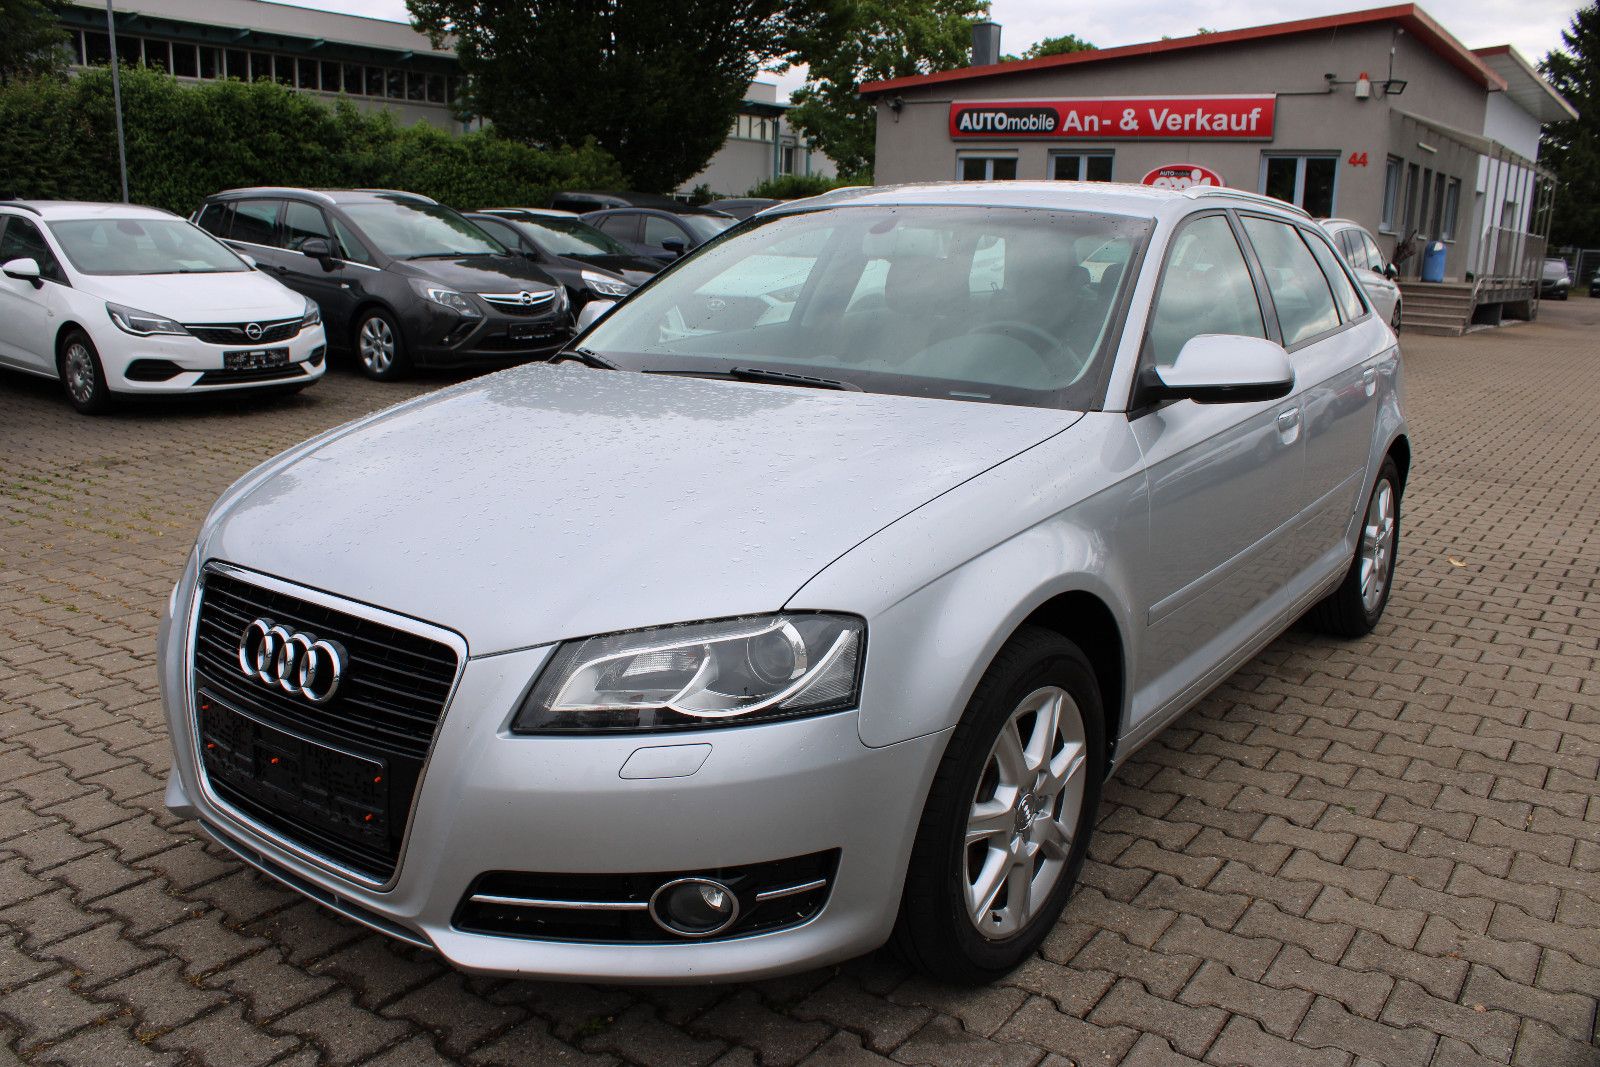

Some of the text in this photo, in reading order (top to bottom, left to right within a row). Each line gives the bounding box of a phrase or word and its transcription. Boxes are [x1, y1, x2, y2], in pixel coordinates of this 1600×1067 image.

[959, 107, 1262, 132] AUTOmobile An- & Verkauf
[1348, 151, 1369, 168] 44
